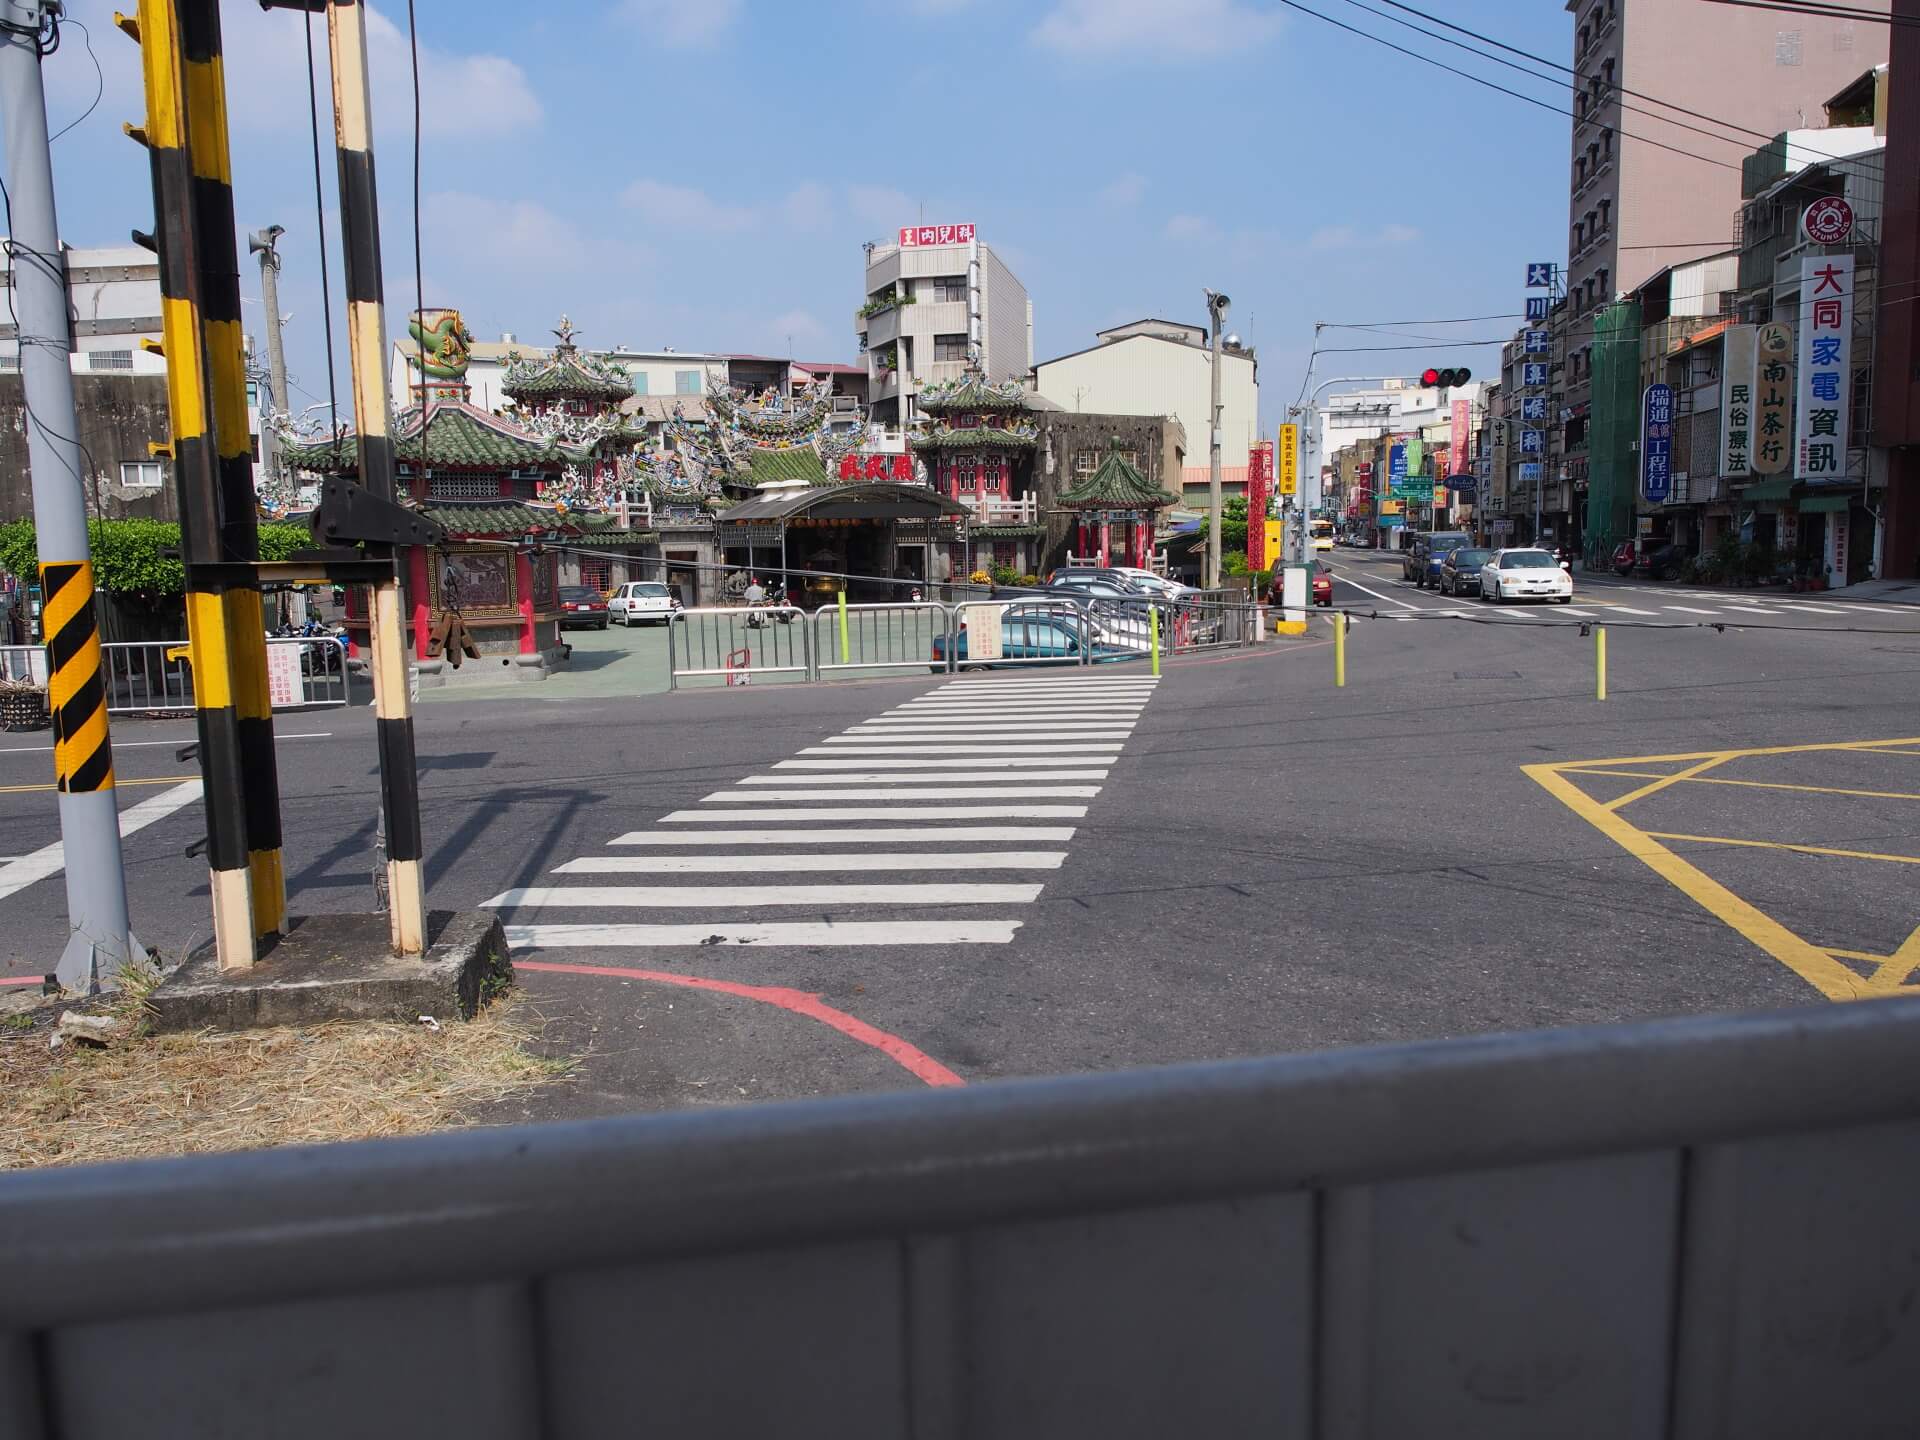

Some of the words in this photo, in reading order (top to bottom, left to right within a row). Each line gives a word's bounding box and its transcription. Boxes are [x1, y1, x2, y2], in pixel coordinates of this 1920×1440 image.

[1809, 224, 1839, 240] TATUNG
[1525, 264, 1548, 449] 大川耳鼻喉科
[1808, 264, 1844, 473] 大同家電資訊
[1728, 384, 1749, 472] 民俗療法
[1760, 359, 1786, 462] 南山茶行
